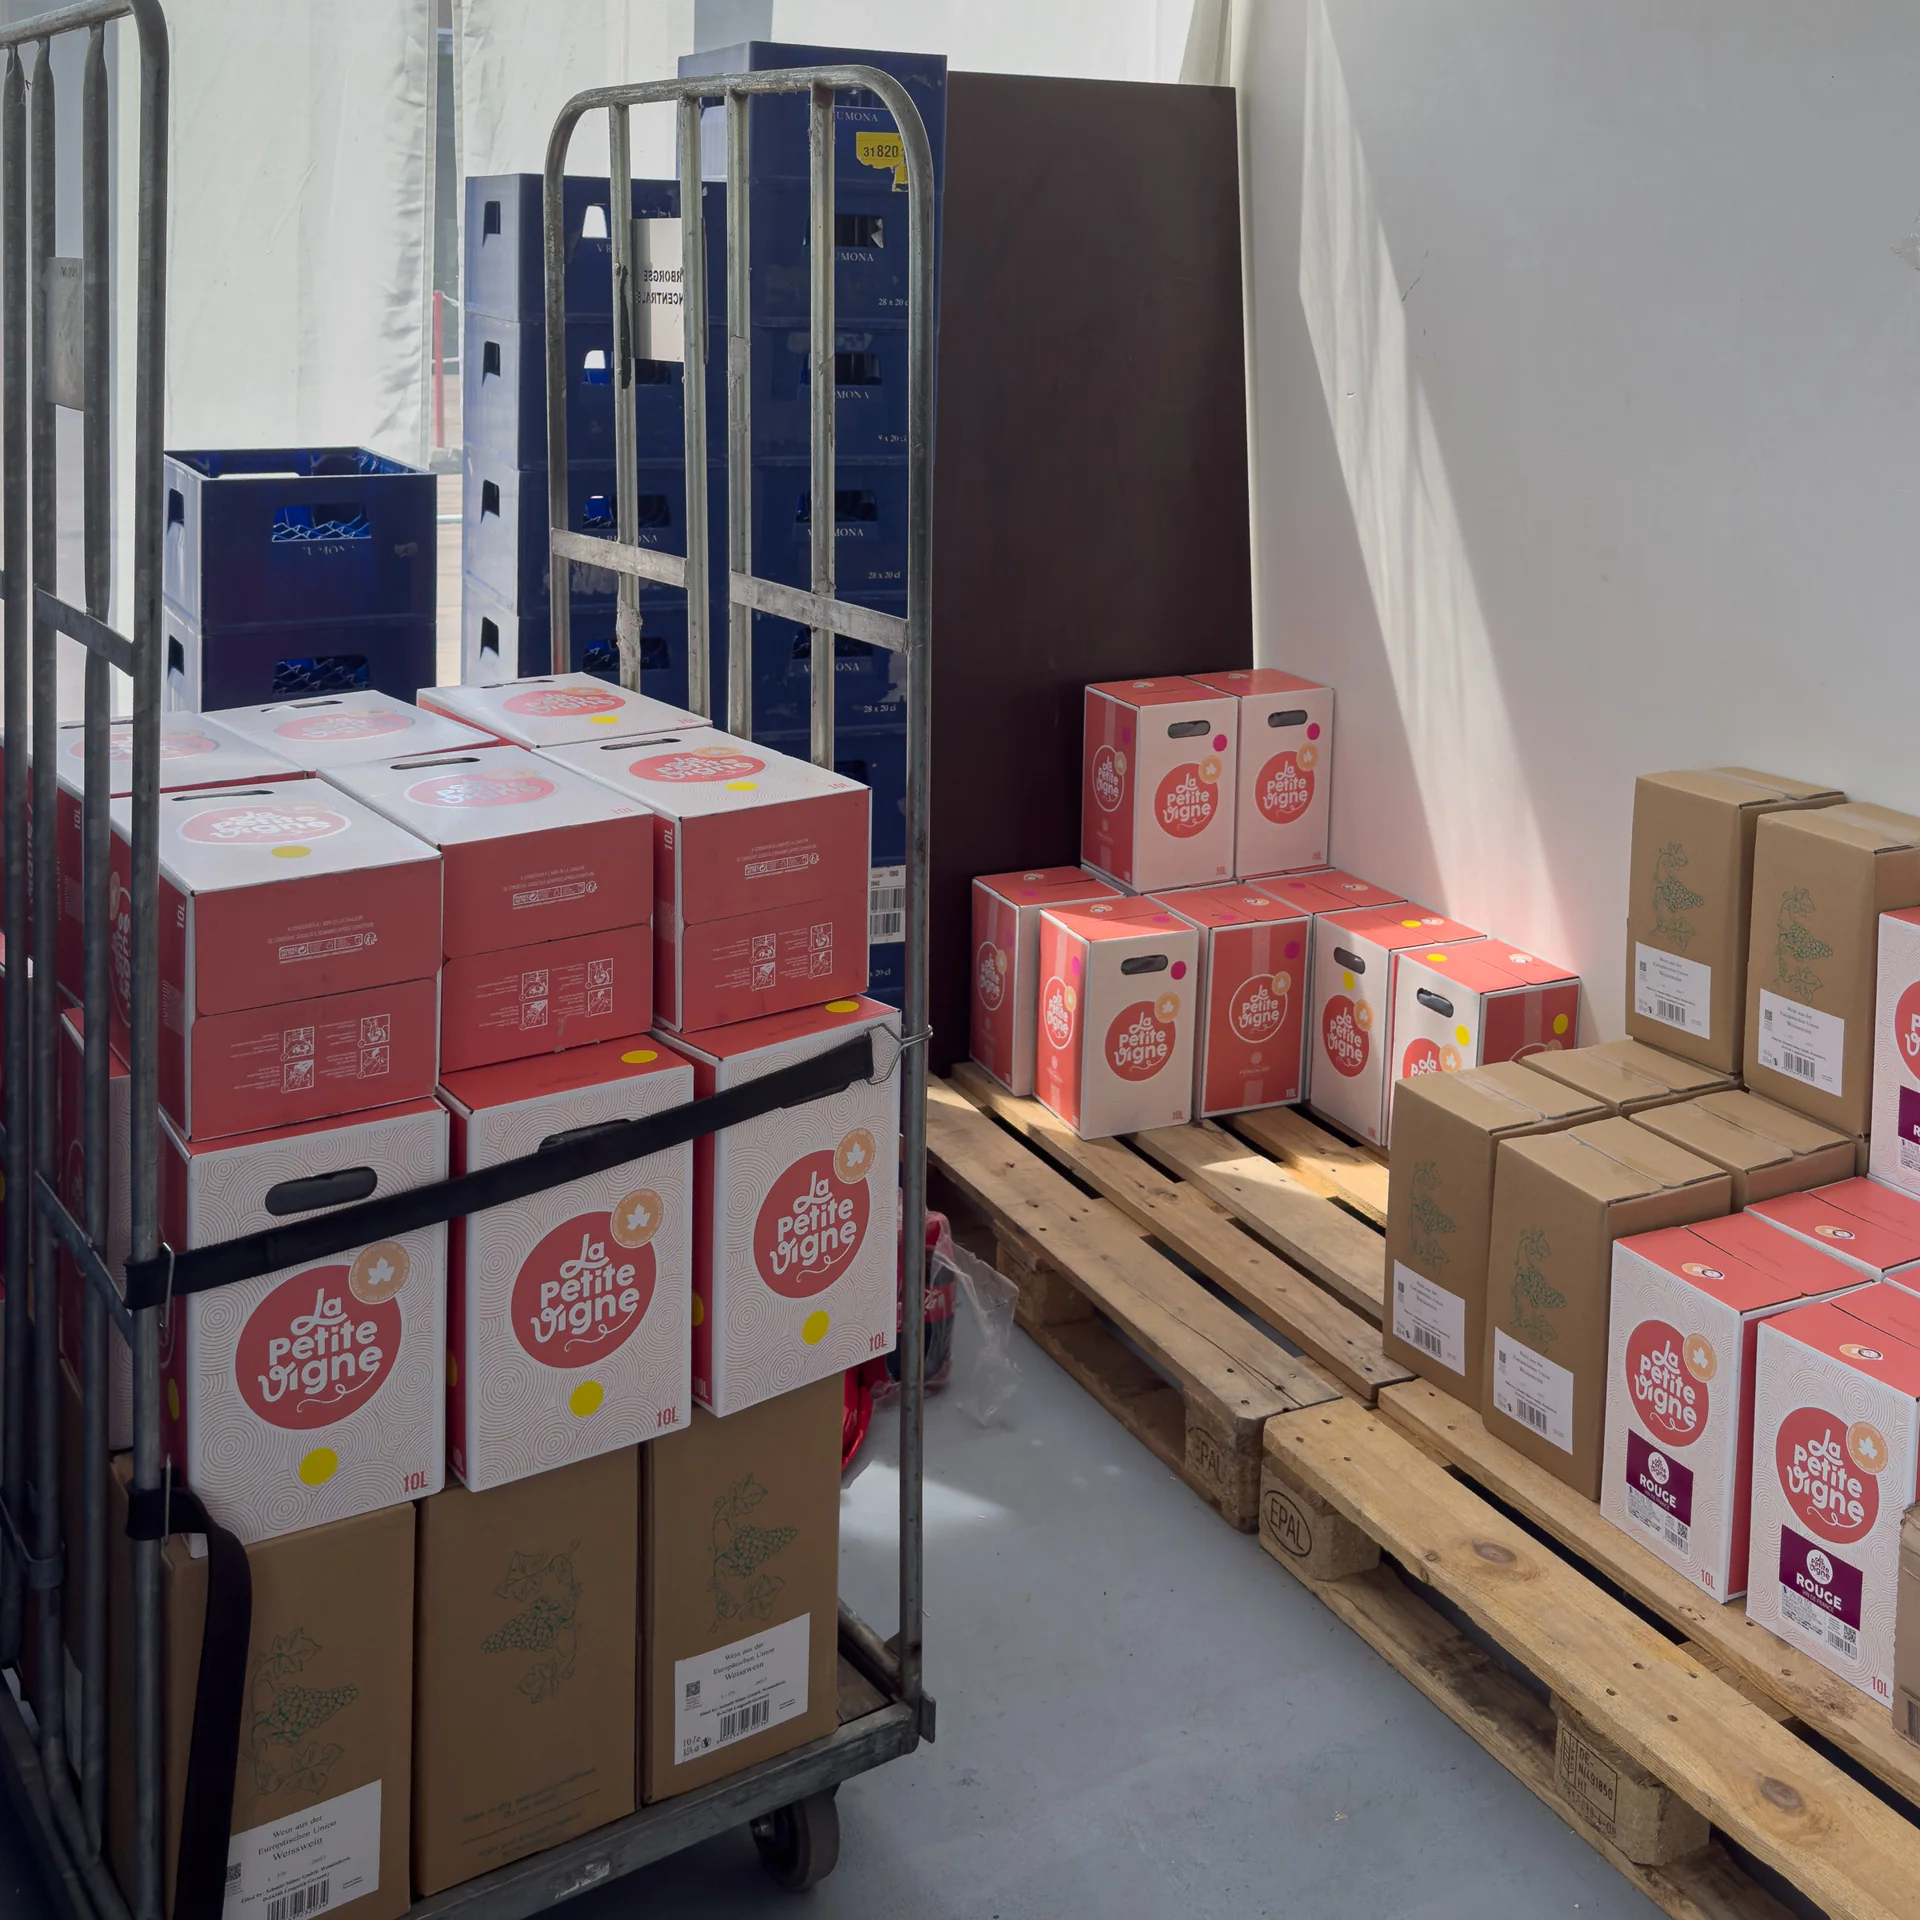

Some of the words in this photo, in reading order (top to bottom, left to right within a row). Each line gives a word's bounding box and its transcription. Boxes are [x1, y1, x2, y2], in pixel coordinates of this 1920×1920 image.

[834, 111, 878, 122] UMONA
[878, 298, 887, 306] 28
[895, 299, 904, 307] 20
[835, 390, 870, 400] MONA
[868, 572, 877, 580] 28
[884, 571, 894, 580] 20
[864, 704, 872, 713] 28
[880, 703, 889, 712] 20
[656, 759, 738, 773] Petite
[659, 762, 754, 779] Vigne
[665, 758, 704, 767] La
[1275, 760, 1295, 779] La
[828, 781, 852, 790] 10L
[1176, 773, 1197, 792] La
[1266, 777, 1306, 793] Petite
[1167, 790, 1209, 807] Petite
[1263, 789, 1308, 810] Vigne
[612, 807, 633, 815] 10L
[1163, 803, 1211, 824] Vigne
[664, 828, 673, 850] 10L
[176, 902, 185, 929] 10L
[1254, 985, 1269, 1001] La
[1242, 999, 1278, 1013] Petite
[1337, 1007, 1351, 1026] La
[1128, 1012, 1151, 1035] La
[1238, 1009, 1280, 1029] Vigne
[1119, 1031, 1166, 1048] Petite
[1330, 1020, 1362, 1046] Petite
[1114, 1044, 1167, 1067] Vigne
[1328, 1032, 1363, 1062] Vigne
[1418, 1051, 1436, 1072] La
[1172, 1111, 1183, 1120] 10L
[793, 1170, 833, 1214] La
[777, 1198, 853, 1242] Petite
[560, 1233, 609, 1279] La
[770, 1221, 857, 1275] Vigne
[540, 1264, 635, 1309] Petite
[290, 1288, 348, 1335] La
[531, 1288, 639, 1343] Vigne
[268, 1320, 377, 1366] Petite
[869, 1331, 887, 1352] 10L
[1652, 1340, 1679, 1375] La
[258, 1346, 383, 1402] Vigne
[1640, 1354, 1696, 1404] Petite
[1634, 1373, 1697, 1427] Vigne
[656, 1406, 679, 1428] 10L
[1808, 1429, 1842, 1466] La
[403, 1471, 428, 1493] 10L
[1794, 1444, 1862, 1499] Petite
[1639, 1472, 1676, 1509] ROUGE
[1787, 1464, 1865, 1524] Vigne
[1270, 1498, 1304, 1551] EPAL
[1701, 1568, 1715, 1591] 10L
[1796, 1572, 1842, 1611] ROUGE
[1872, 1676, 1889, 1699] 10L
[272, 1827, 293, 1838] Wein
[295, 1820, 308, 1830] aus
[310, 1815, 323, 1825] der
[313, 1820, 337, 1834] Union
[272, 1837, 323, 1862] Weisswein
